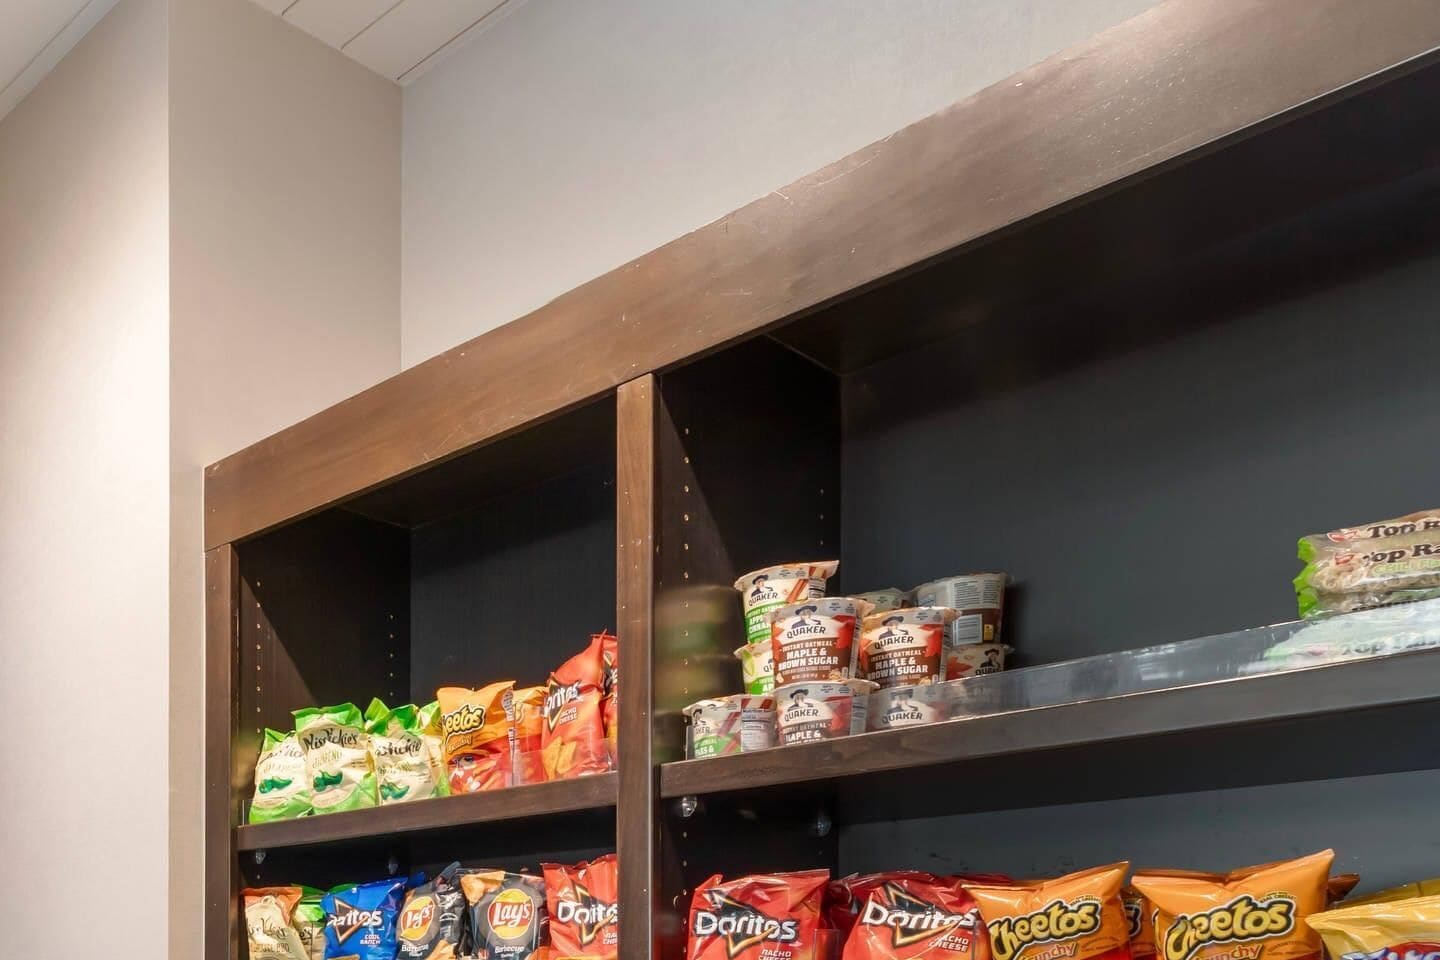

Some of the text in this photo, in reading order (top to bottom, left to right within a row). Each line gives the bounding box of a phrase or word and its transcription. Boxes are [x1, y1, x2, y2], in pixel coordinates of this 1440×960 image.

[748, 592, 778, 606] QUAKER
[787, 626, 826, 639] QUAKER
[875, 636, 914, 649] QUAKER
[787, 648, 827, 660] MAPLE &
[807, 657, 839, 667] SUGAR
[876, 659, 907, 670] MAPLE
[897, 665, 928, 675] SUGAR
[784, 709, 819, 722] QUAKER
[882, 711, 922, 725] QUAKER
[494, 902, 530, 927] Lay's
[862, 902, 977, 928] Doritos
[696, 911, 798, 941] Doritos
[762, 949, 791, 958] NACHO
